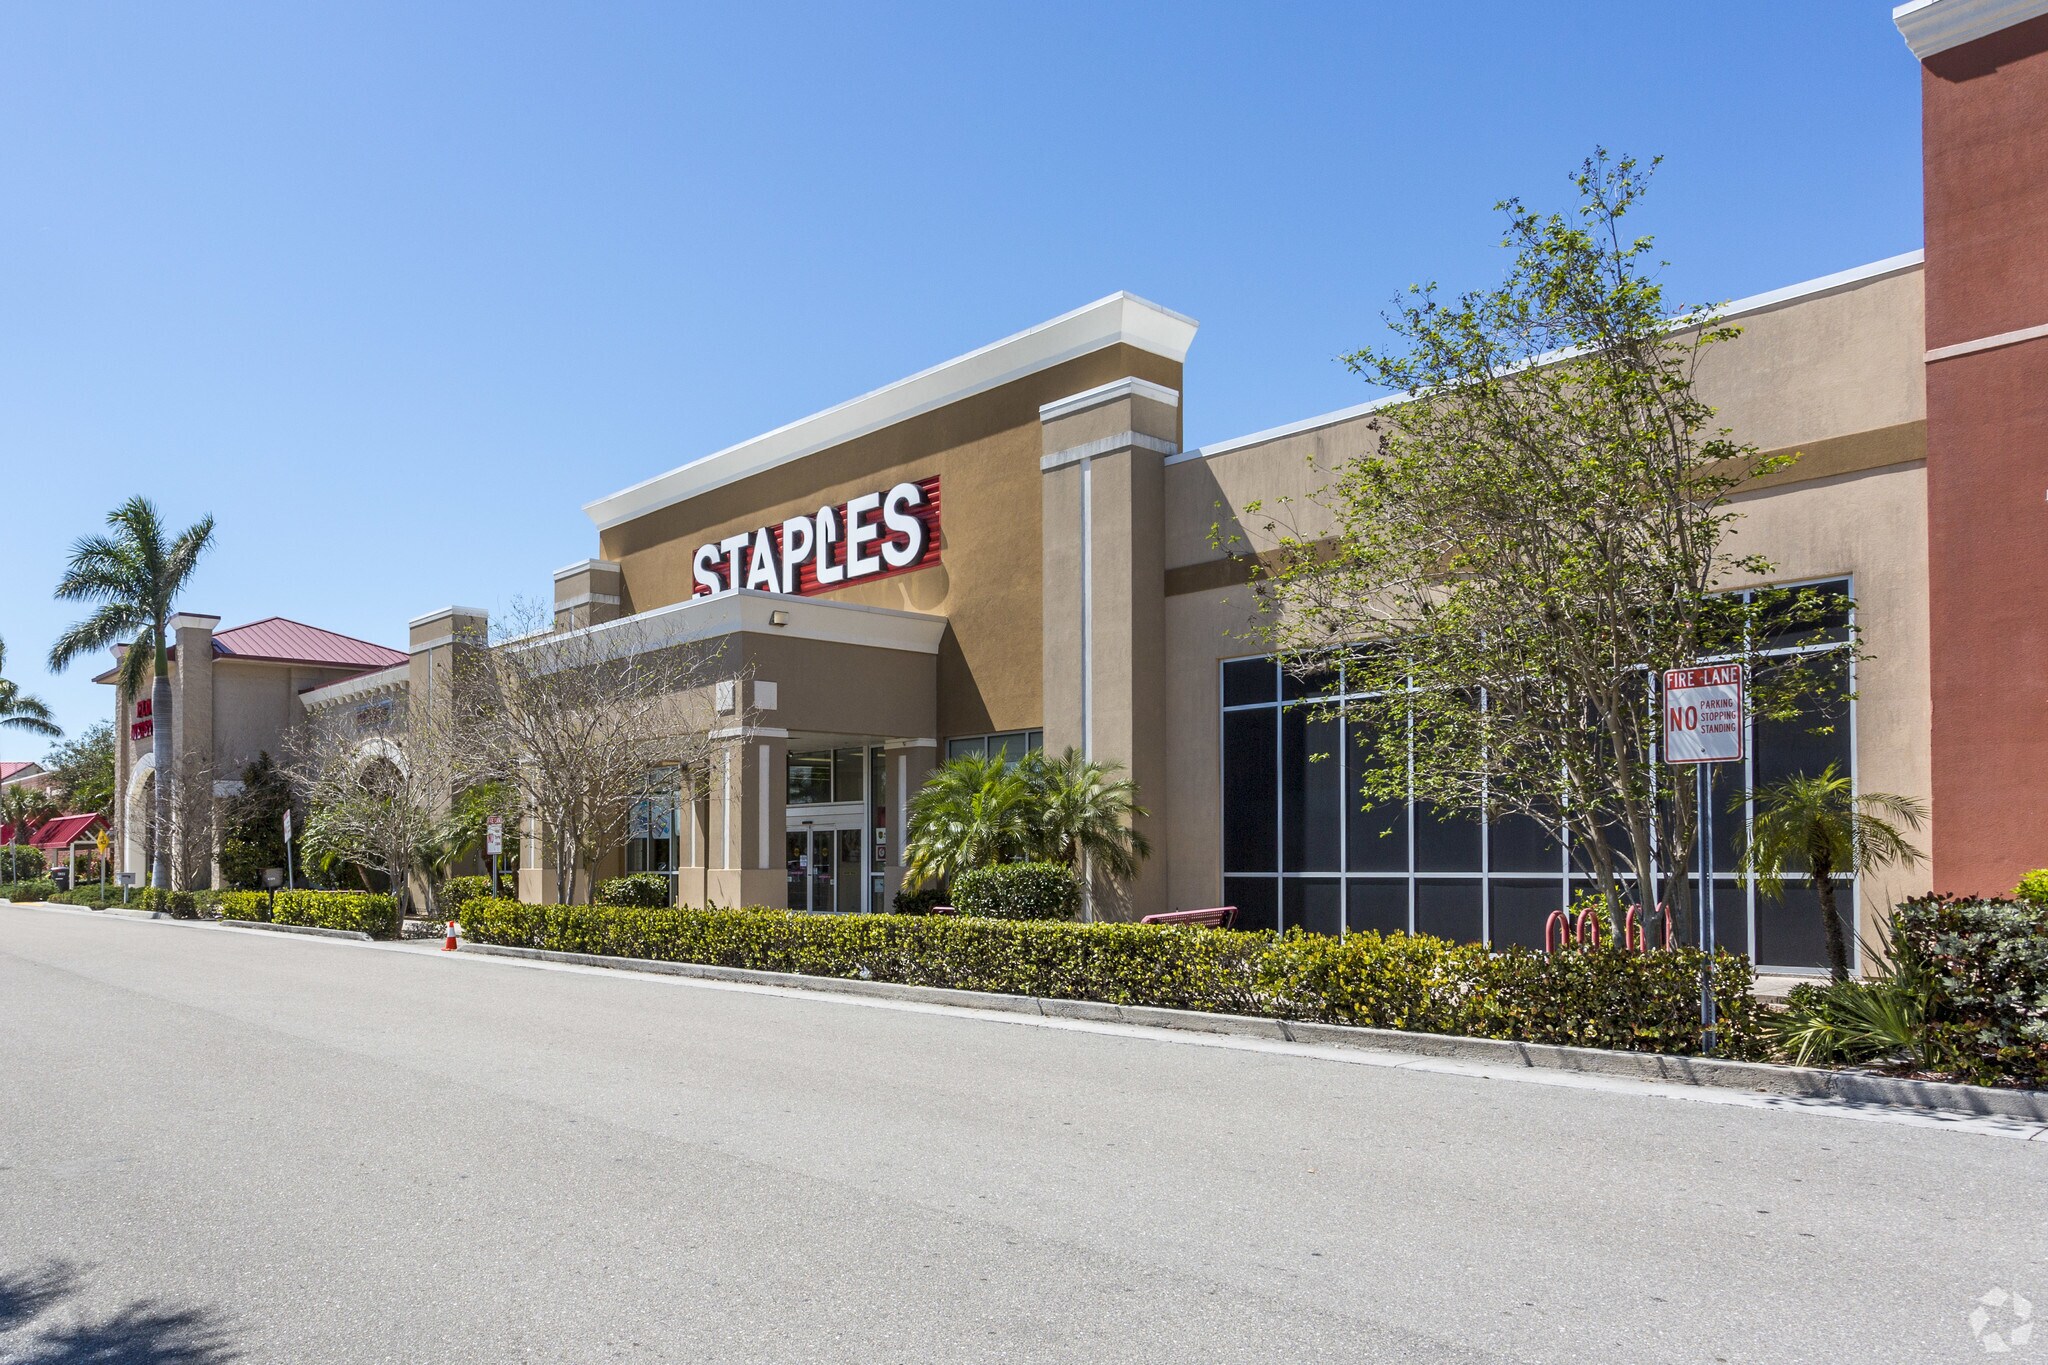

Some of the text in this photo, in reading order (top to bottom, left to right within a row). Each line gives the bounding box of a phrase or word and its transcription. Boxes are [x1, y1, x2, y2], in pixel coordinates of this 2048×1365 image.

[692, 482, 930, 600] STAPLES
[1667, 667, 1738, 688] FIRE LANE
[1701, 699, 1733, 709] PARKING
[1670, 706, 1697, 732] NO
[1701, 711, 1736, 721] STOPPING
[1701, 723, 1736, 733] STANDING
